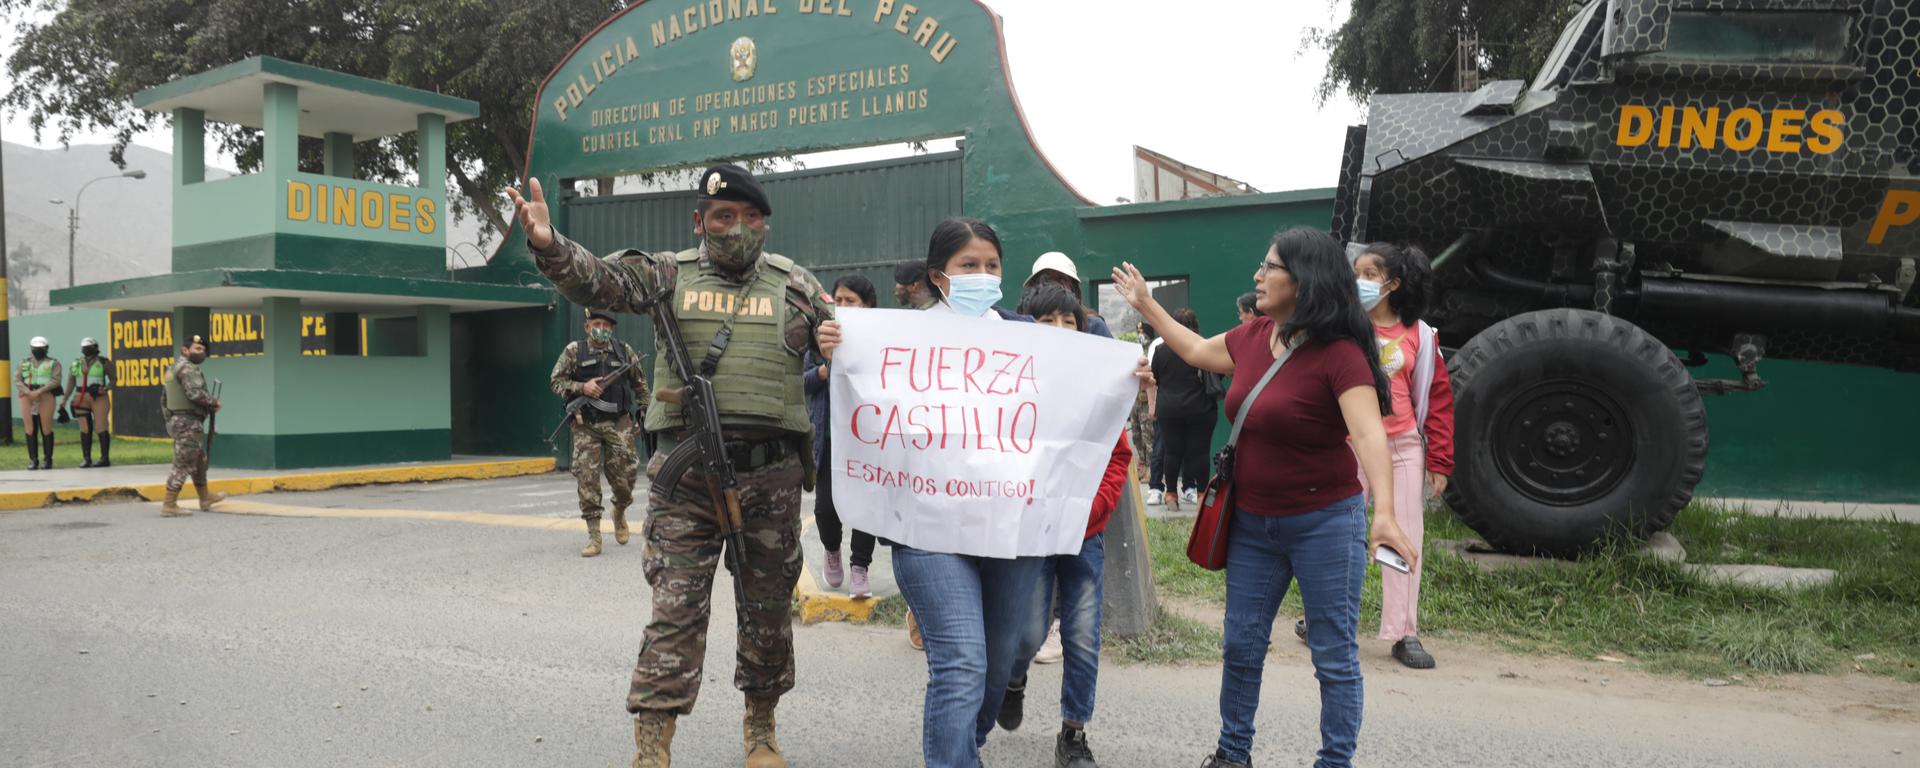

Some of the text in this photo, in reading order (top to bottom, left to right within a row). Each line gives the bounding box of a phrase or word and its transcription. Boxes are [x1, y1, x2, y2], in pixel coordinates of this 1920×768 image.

[554, 36, 639, 121] POLICIA
[651, 0, 778, 48] NACIONAL
[873, 0, 958, 64] PERU
[582, 128, 640, 153] CUARTEL
[693, 117, 721, 138] PNP
[730, 110, 779, 133] MARCO
[789, 100, 850, 128] PUENTE
[861, 89, 929, 117] LLANOS
[591, 64, 910, 128] DIRECCION DE OPERACIONES ESPECIALES
[1616, 104, 1845, 155] DINOES
[287, 180, 437, 235] DINOES
[682, 290, 774, 317] POLICIA
[113, 317, 174, 349] POLICIA
[209, 313, 258, 342] ONAL
[115, 357, 175, 387] DIRECC
[880, 346, 1040, 396] FUERZA
[850, 401, 1038, 454] CASTILLO
[847, 459, 1036, 506] ESTAMOS CONTIGO!
